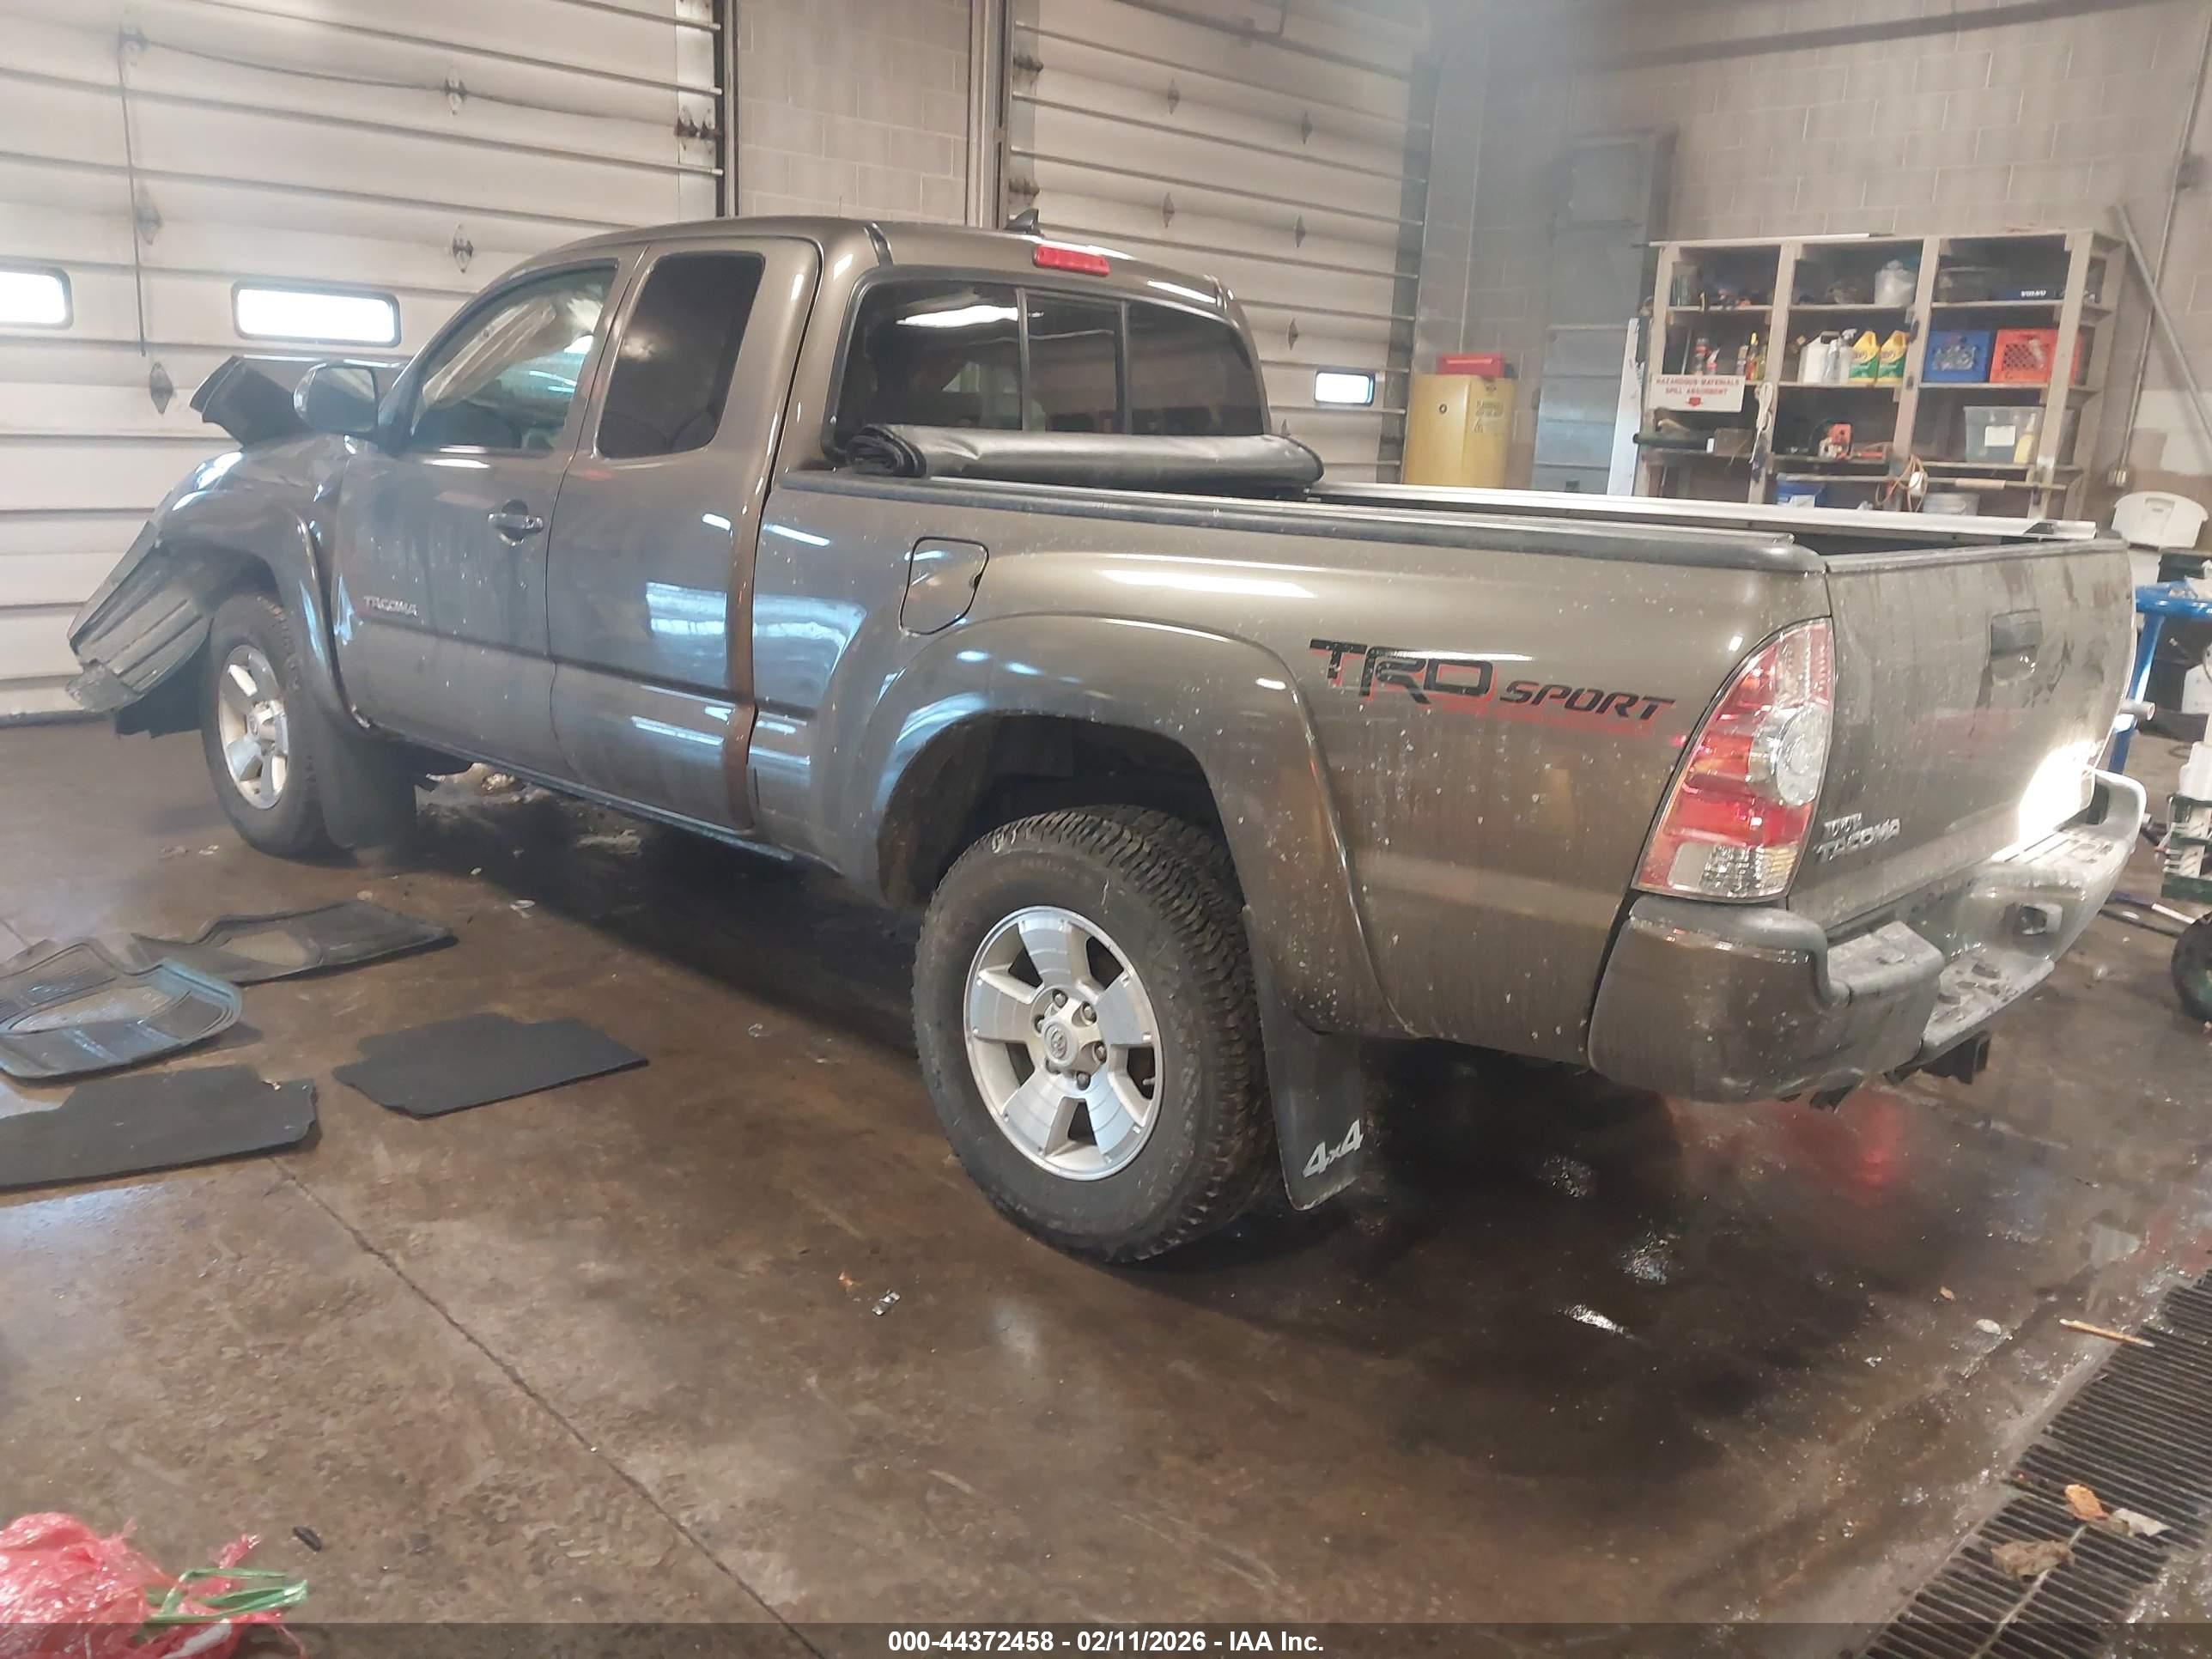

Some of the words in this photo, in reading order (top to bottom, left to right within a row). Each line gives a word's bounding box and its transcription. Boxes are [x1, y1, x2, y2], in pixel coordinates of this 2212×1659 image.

[1665, 386, 1682, 395] SPILL
[363, 596, 418, 617] TACOMA
[1310, 638, 1494, 704] TRD
[1499, 680, 1675, 720] SPORT
[1813, 817, 1900, 862] TACOMA
[1302, 1118, 1364, 1178] 4x4
